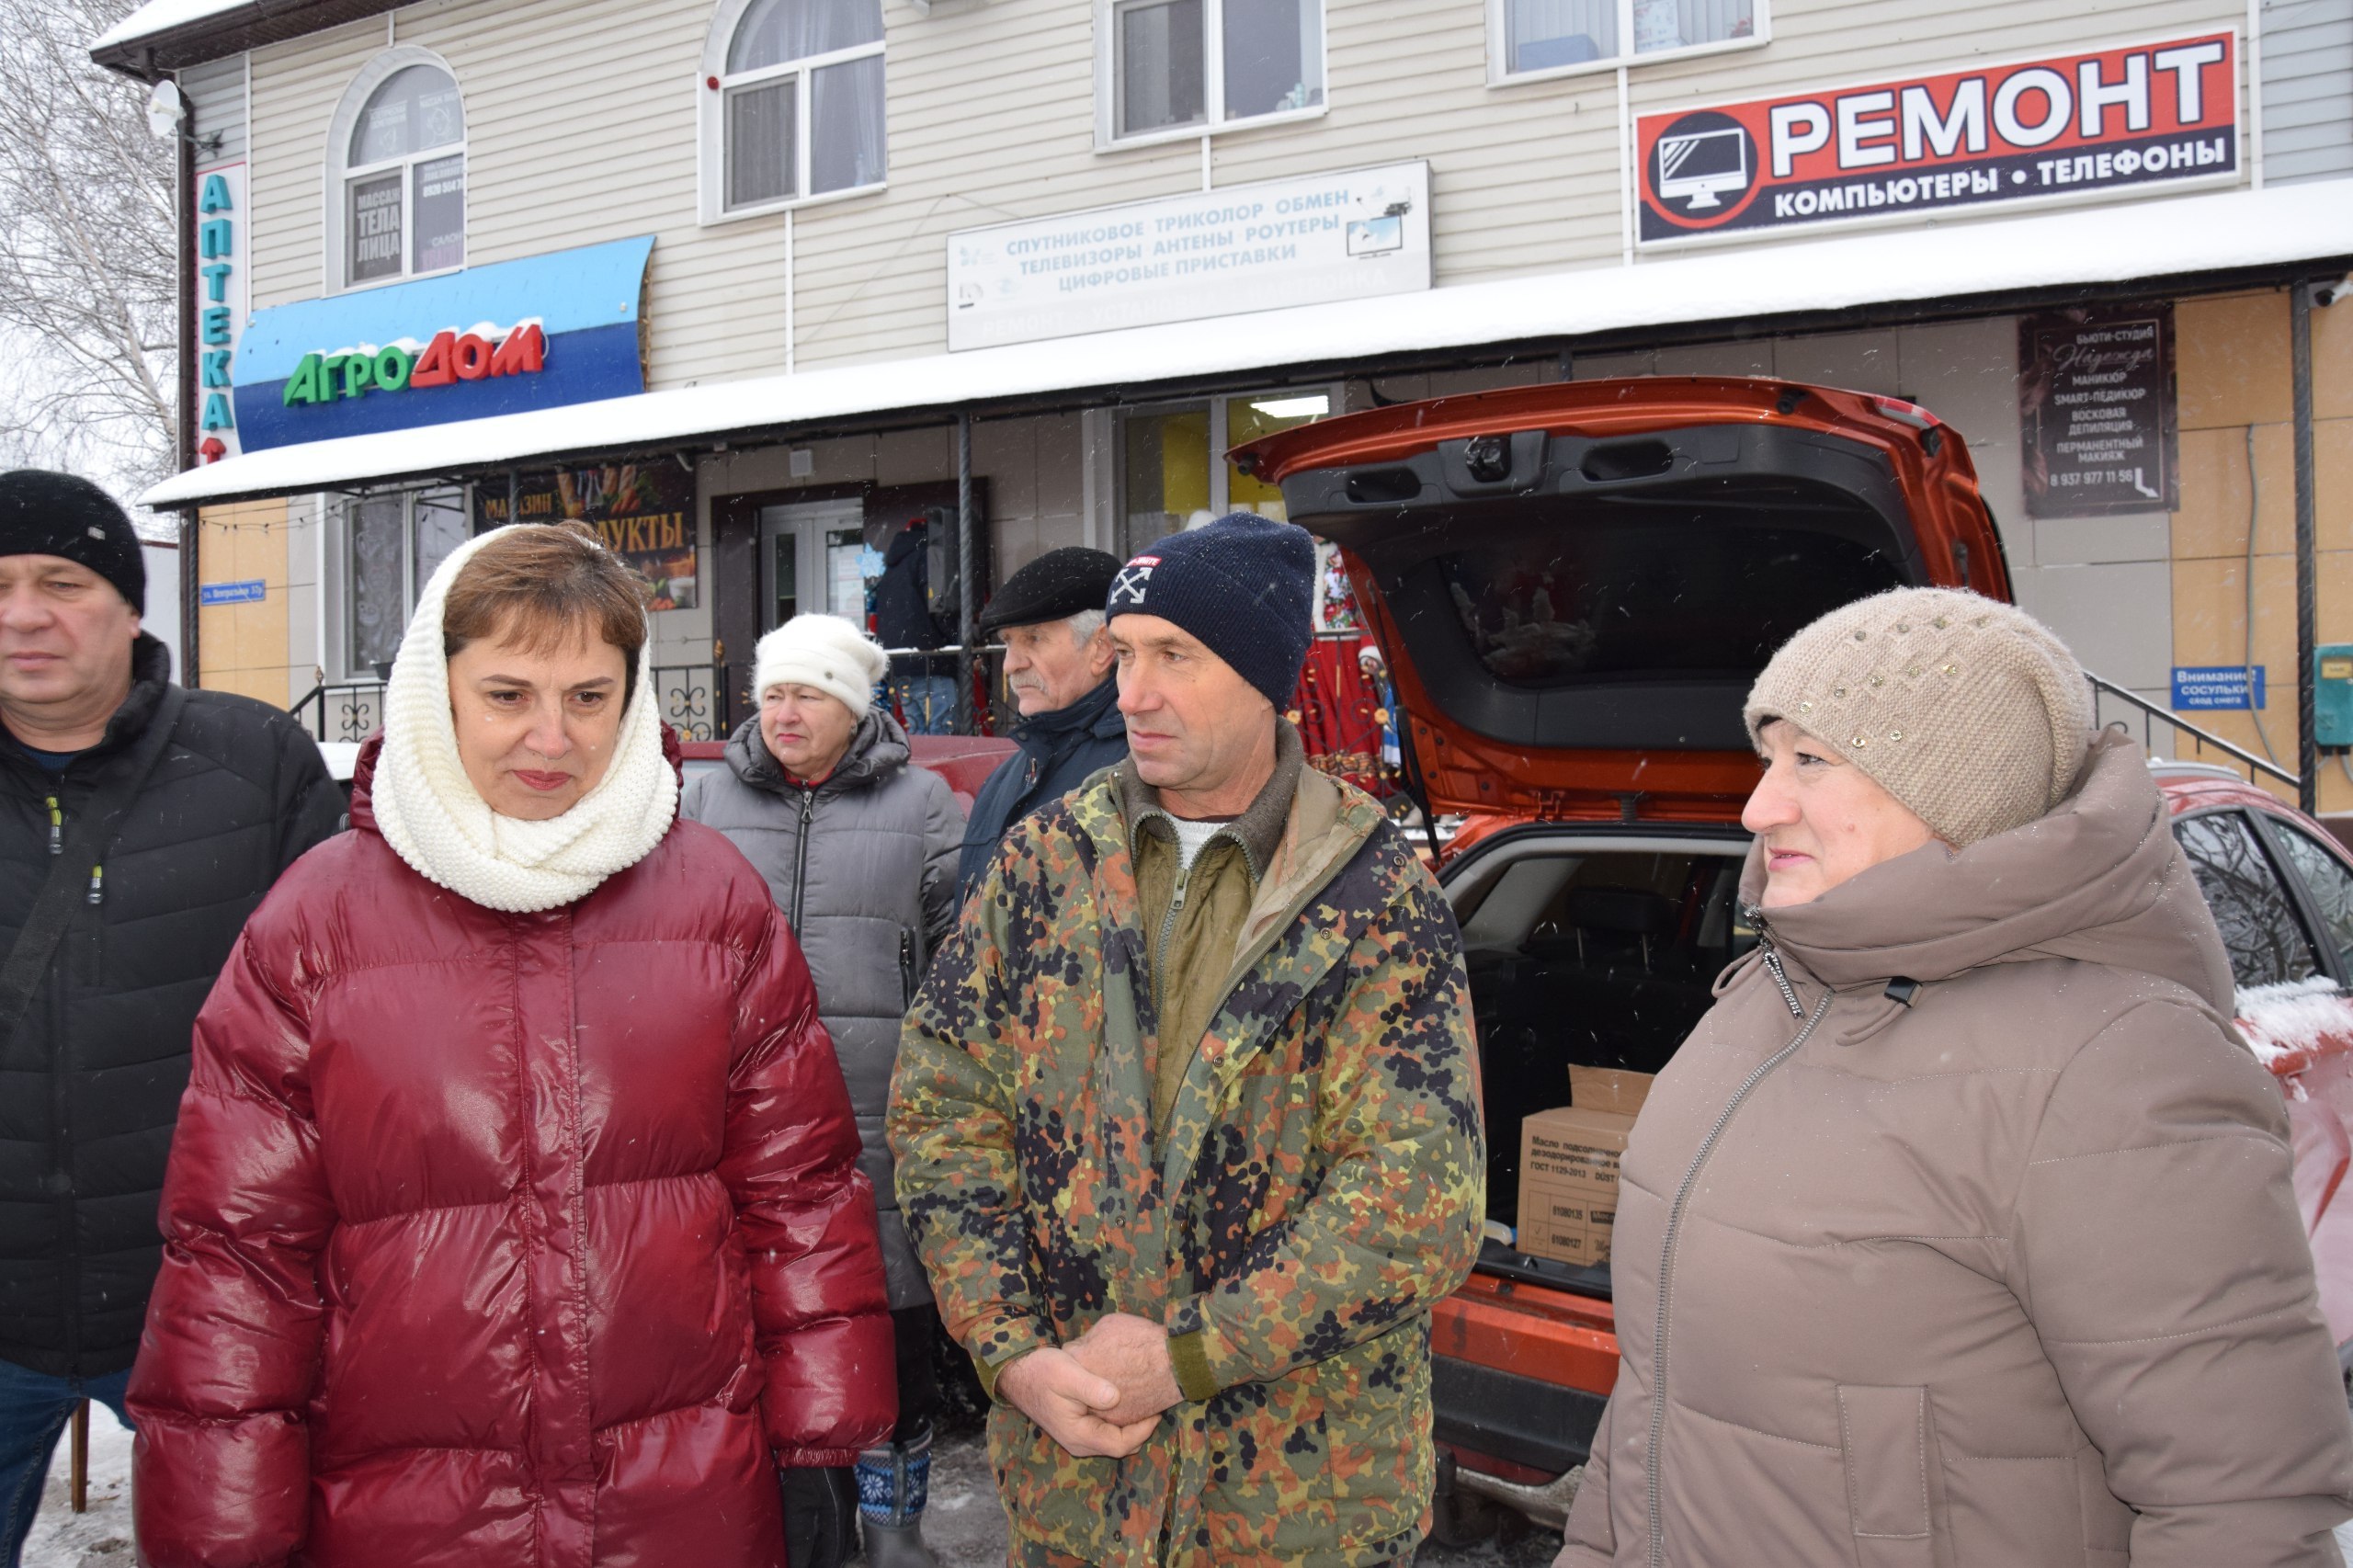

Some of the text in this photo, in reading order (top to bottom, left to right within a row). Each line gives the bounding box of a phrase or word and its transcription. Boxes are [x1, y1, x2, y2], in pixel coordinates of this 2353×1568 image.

[1769, 40, 2224, 177] РЕМОНТ
[1775, 138, 2225, 218] КОМПЬЮТЕРЫ ТЕЛЕФОНЫ
[357, 187, 402, 210] МАССАЖ
[357, 203, 401, 238] ТЕЛА
[1006, 189, 1349, 256] СПУТНИКОВОЕ ТРИКОЛОР ОБМЕН
[357, 232, 401, 262] ЛИЦА
[1019, 215, 1339, 275] ТЕЛЕВИЗОРЫ АНТЕНЫ РОУТЕРЫ
[1059, 244, 1296, 292] ЦИФРОВЫЕ ПРИСТАВКИ
[199, 174, 233, 431] АПТЕКА
[2075, 327, 2154, 345] БЬЮТИ-СТУДИЯ
[2052, 343, 2154, 373] Надежда
[2072, 371, 2128, 386] МАНИКЮР
[2054, 388, 2146, 405] SMART-ПЕДИКЮР
[2071, 407, 2127, 422] ВОСКОВАЯ
[2068, 420, 2133, 436] ДЕПИЛЯЦИЯ
[2057, 435, 2143, 453] ПЕРМАНЕНТНЫЙ
[2078, 449, 2125, 463] МАКИЯЖ
[2050, 473, 2058, 487] 8
[2060, 472, 2081, 486] 937
[2083, 471, 2103, 484] 977
[2106, 470, 2116, 483] 11
[485, 492, 552, 518] МАЗИН
[1531, 1135, 1559, 1148] Масло
[1530, 1161, 1586, 1178] ГОСТ 1129-2013
